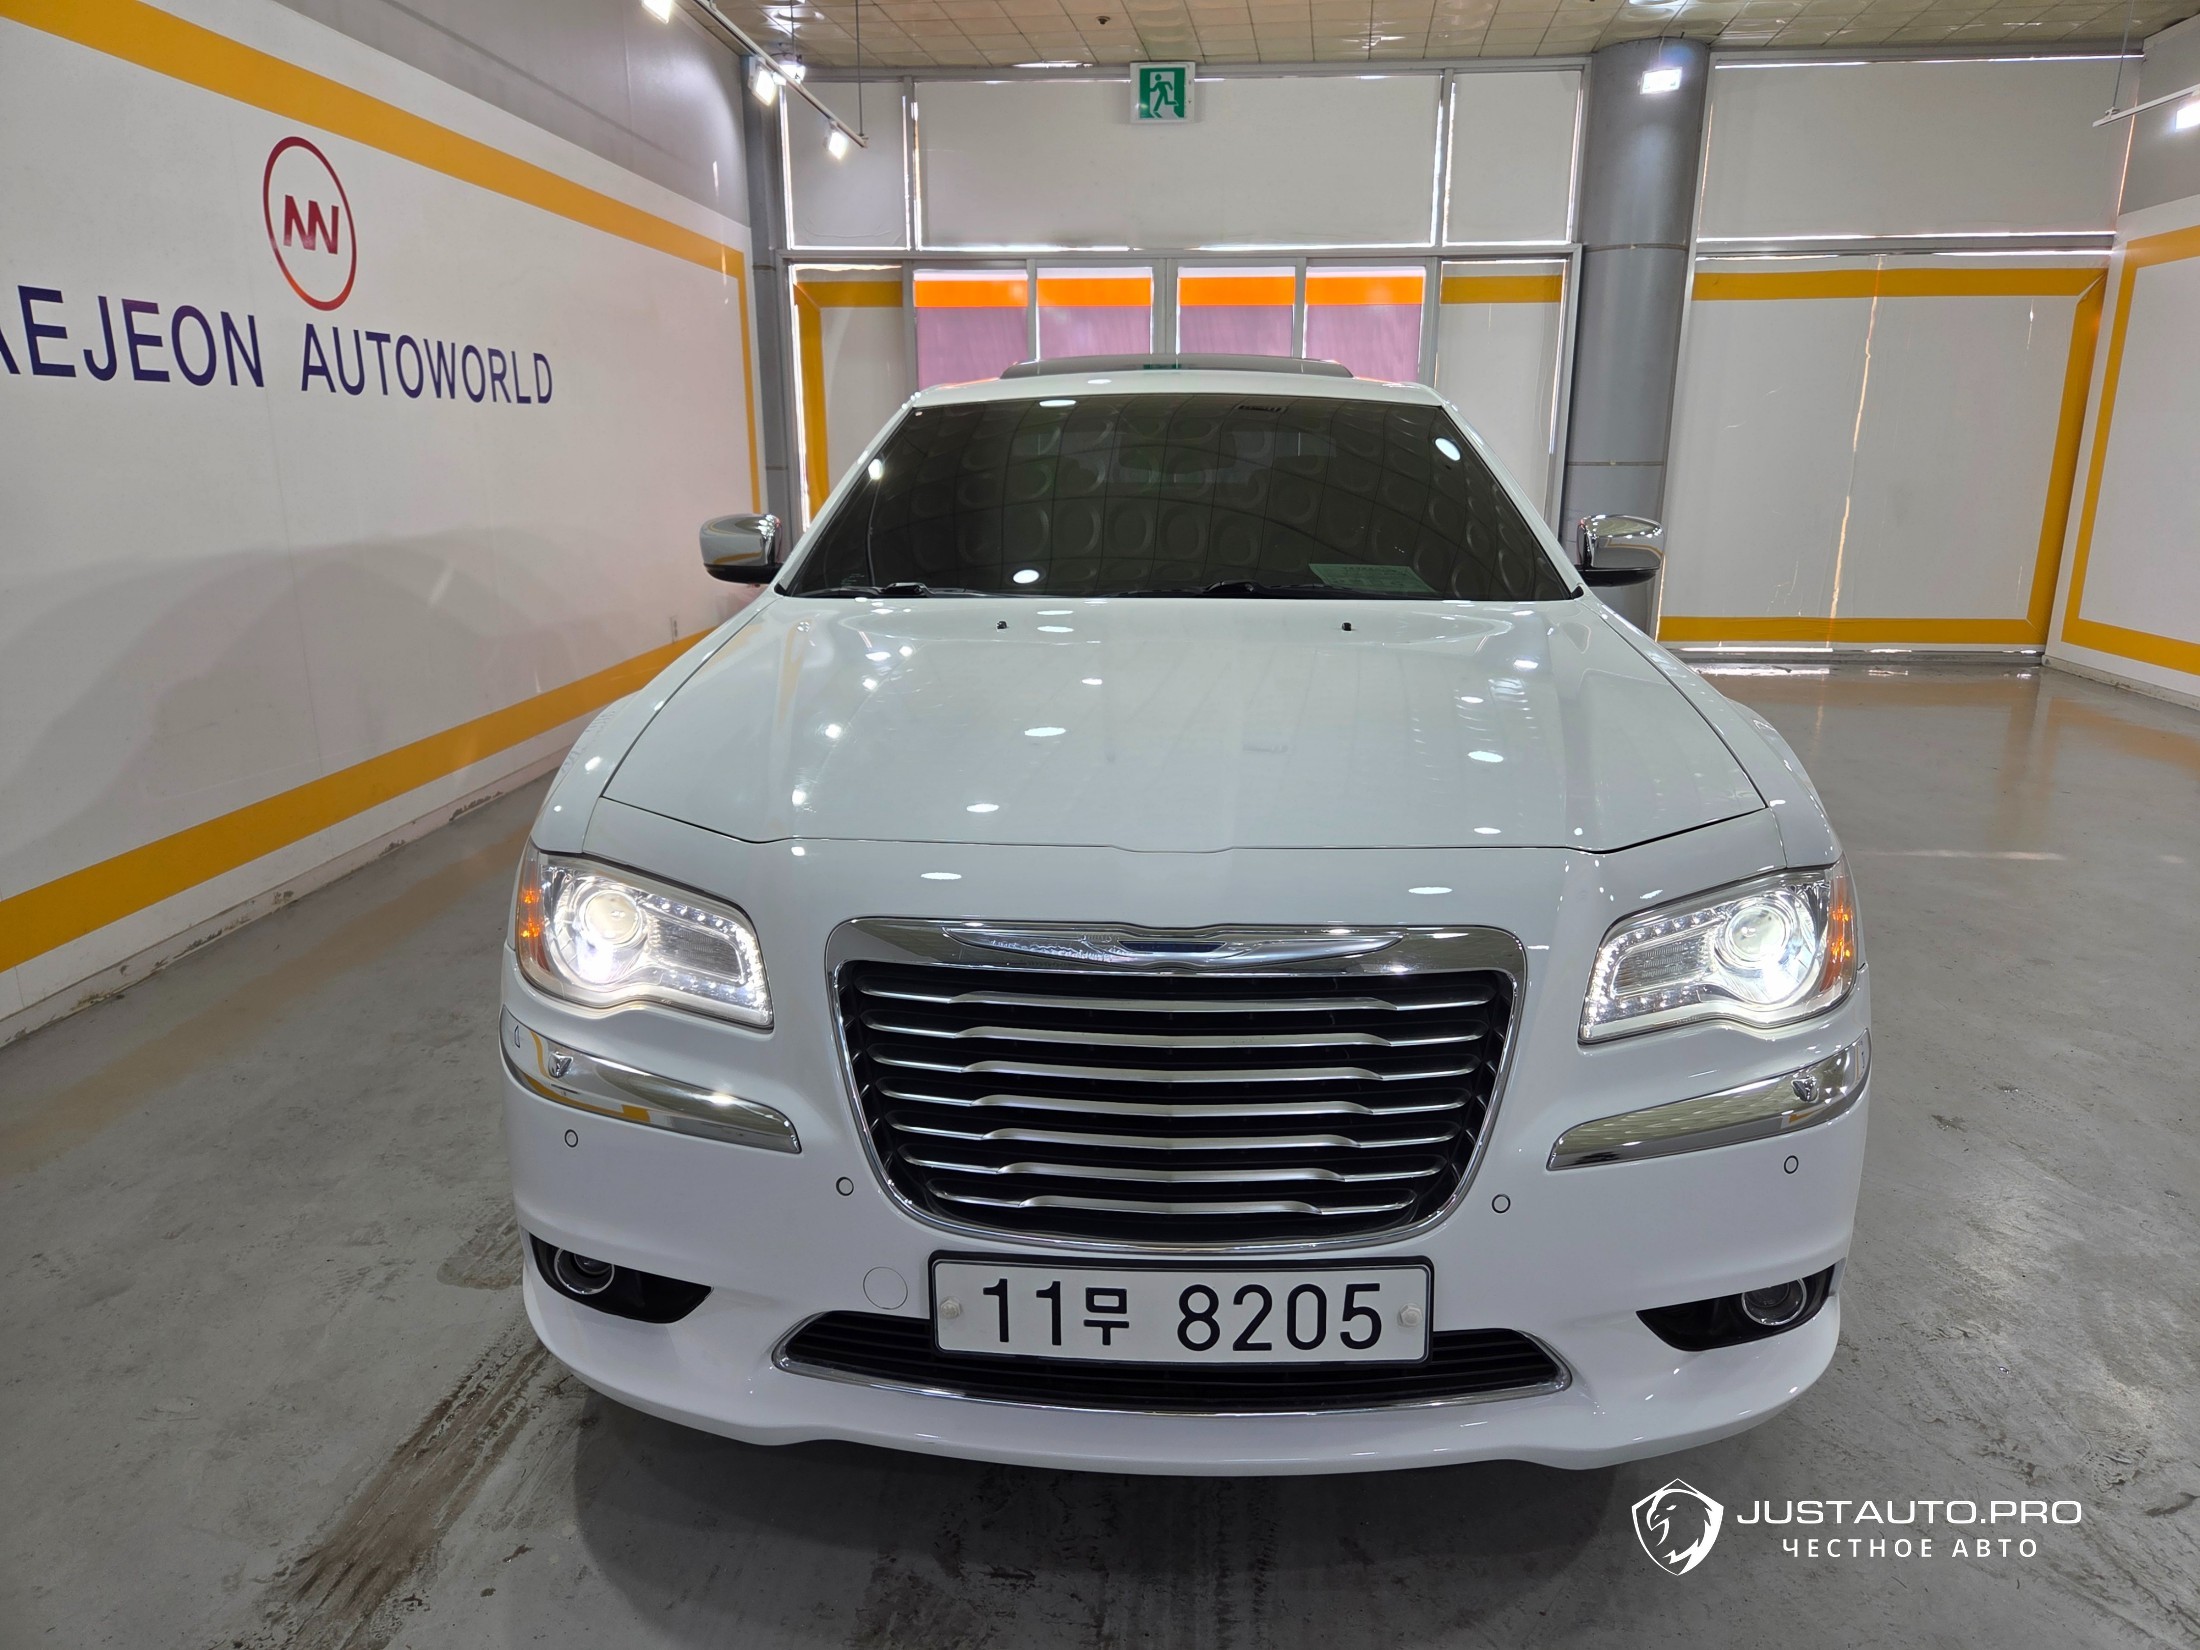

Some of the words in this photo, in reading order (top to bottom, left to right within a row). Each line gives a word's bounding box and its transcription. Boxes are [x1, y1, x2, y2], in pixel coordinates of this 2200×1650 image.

[301, 323, 553, 404] AUTOWORLD
[982, 1278, 1130, 1347] 11무
[1176, 1282, 1383, 1352] 8205
